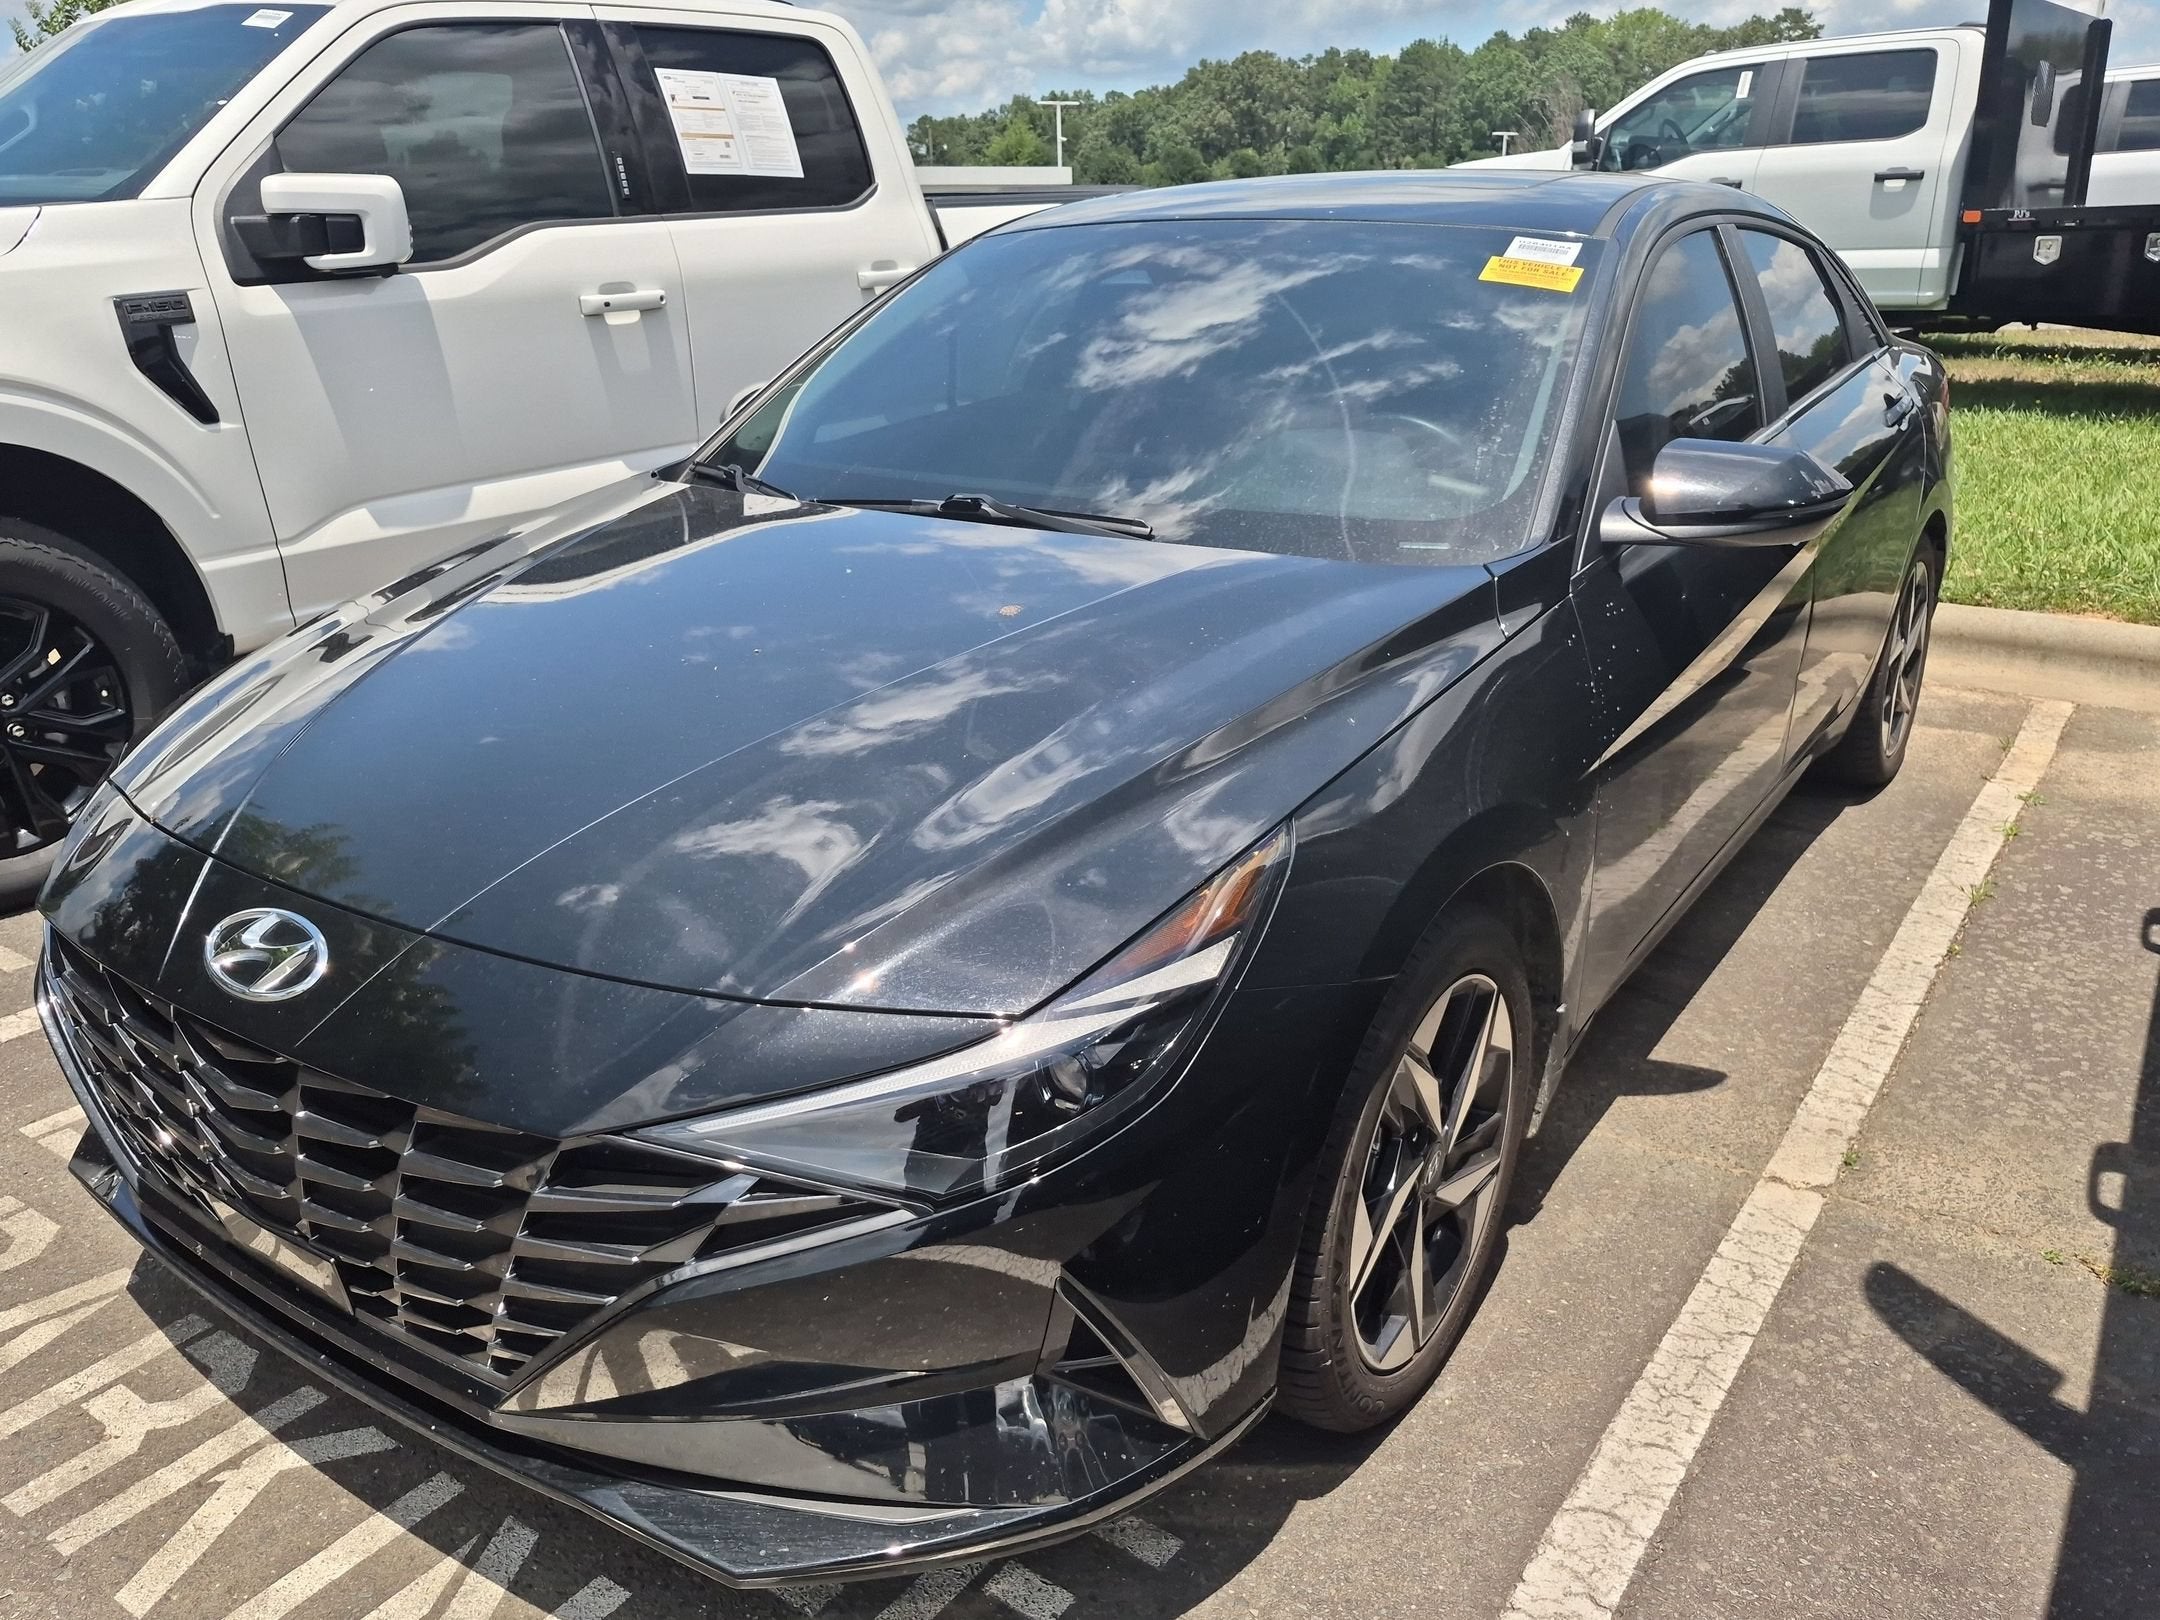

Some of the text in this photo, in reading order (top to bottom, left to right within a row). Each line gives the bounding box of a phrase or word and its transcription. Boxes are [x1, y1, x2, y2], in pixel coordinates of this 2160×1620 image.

[1498, 258, 1519, 266] THIS
[1522, 261, 1563, 271] VEHICLE
[1542, 269, 1567, 277] SALE
